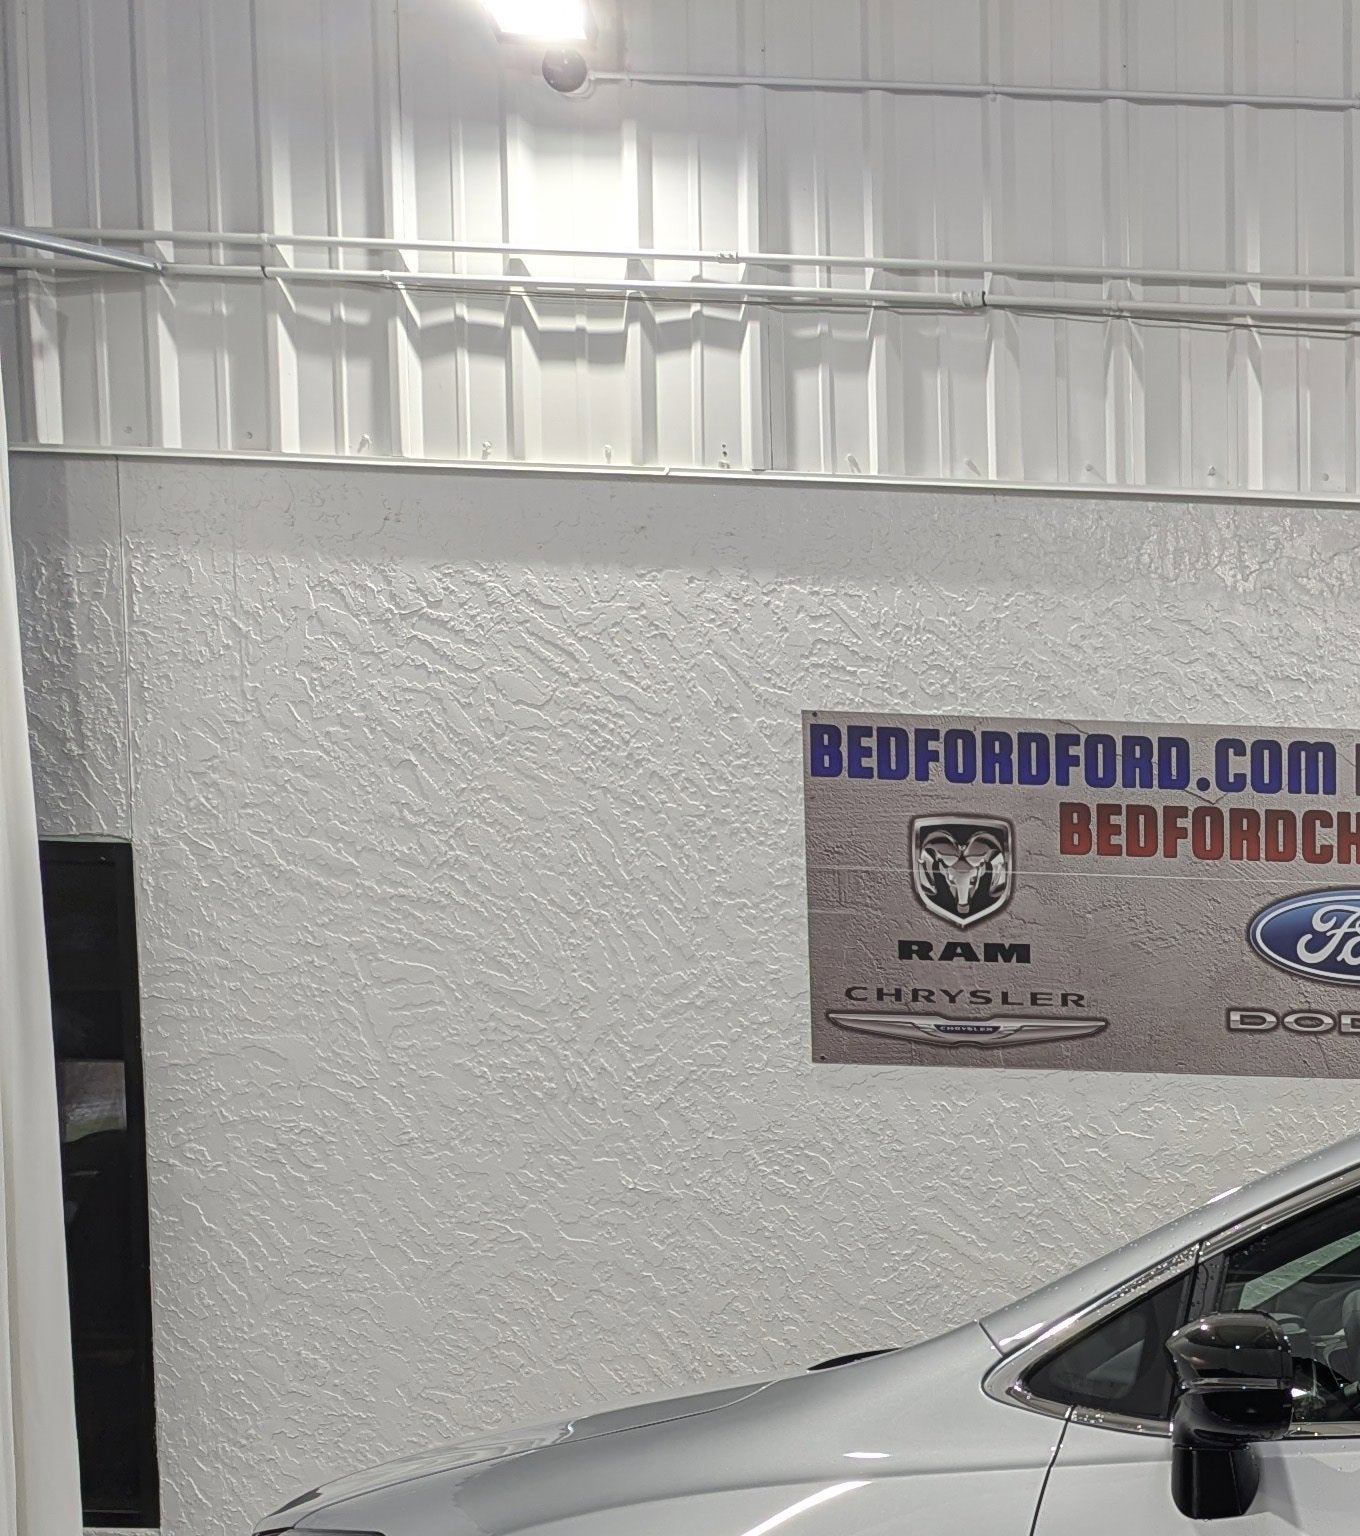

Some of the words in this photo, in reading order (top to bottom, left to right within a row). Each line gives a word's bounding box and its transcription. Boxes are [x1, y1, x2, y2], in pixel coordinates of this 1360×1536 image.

[810, 723, 1336, 796] BEDFORDFORD.COM
[897, 939, 1032, 964] RAM
[844, 986, 1086, 1008] CHRYSLER
[939, 1025, 995, 1033] CHRYSLER
